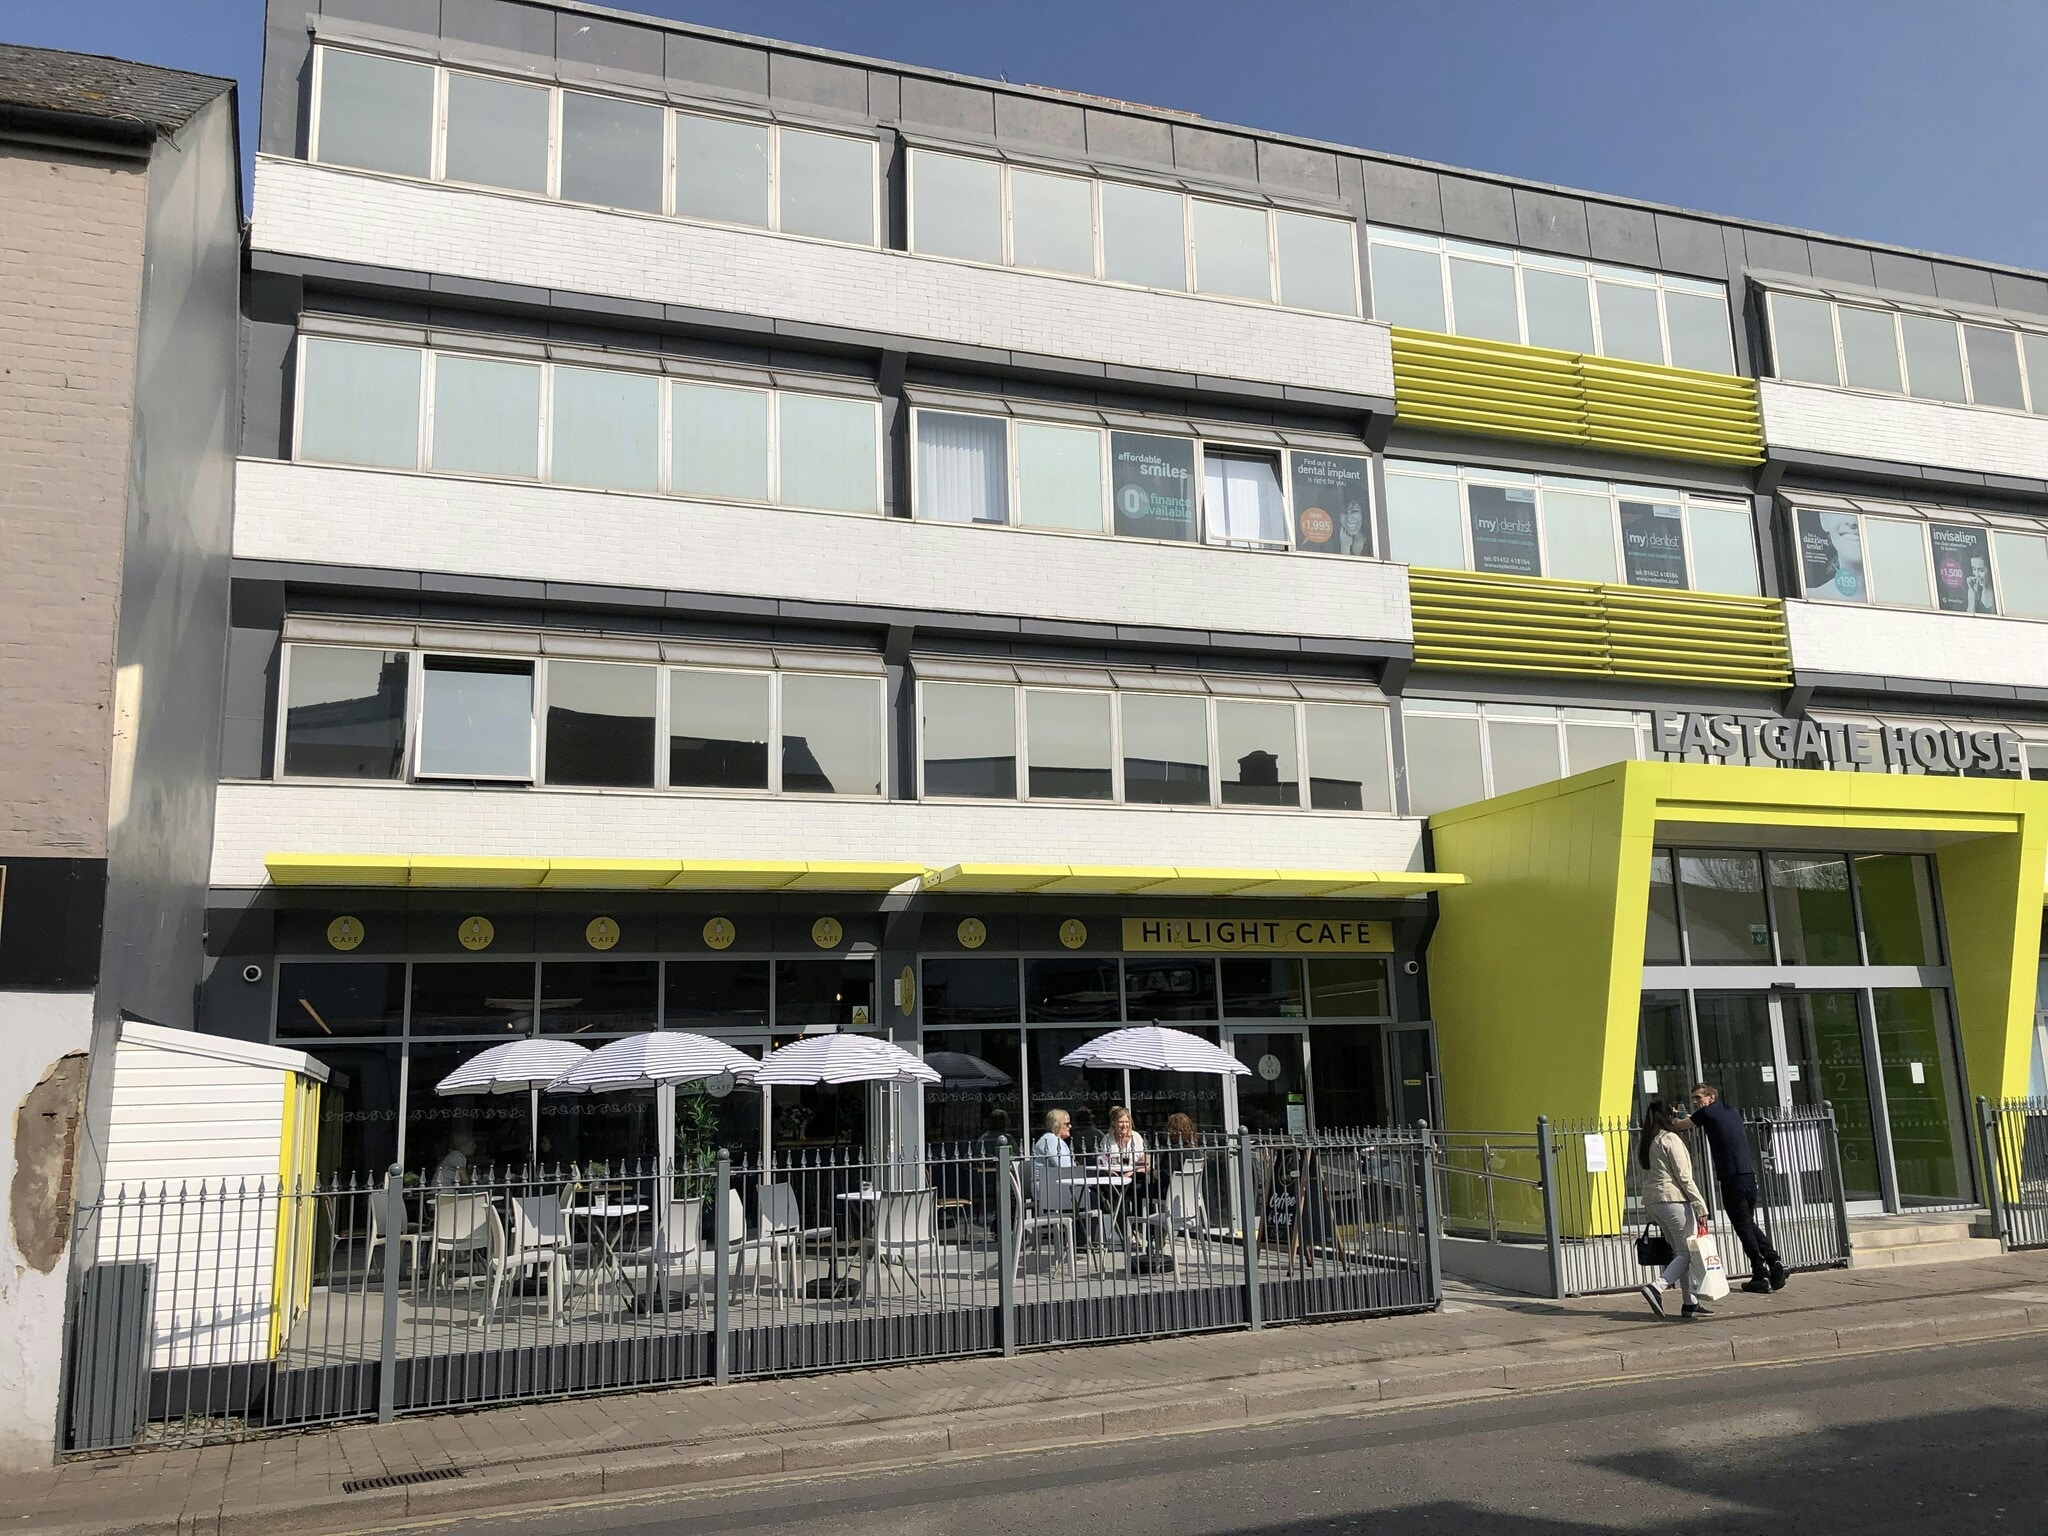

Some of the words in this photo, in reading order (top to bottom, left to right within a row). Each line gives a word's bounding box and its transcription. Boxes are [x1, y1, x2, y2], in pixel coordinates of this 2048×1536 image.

[1118, 452, 1162, 464] affordable
[1304, 458, 1316, 466] Find
[1140, 463, 1188, 479] smiles
[1298, 464, 1326, 476] dental
[1327, 467, 1361, 480] implant
[1314, 477, 1327, 485] right
[1327, 477, 1335, 485] for
[1150, 493, 1192, 508] finance
[1140, 504, 1192, 518] available
[1803, 535, 1829, 547] dazzling
[1932, 528, 1977, 546] invisalign
[1652, 709, 1873, 764] EASTGATE
[1879, 726, 2023, 773] HOUSE
[1827, 995, 1838, 1013] 4
[1831, 1040, 1842, 1059] 3
[1835, 1072, 1847, 1091] 2
[1704, 1255, 1722, 1265] TES
